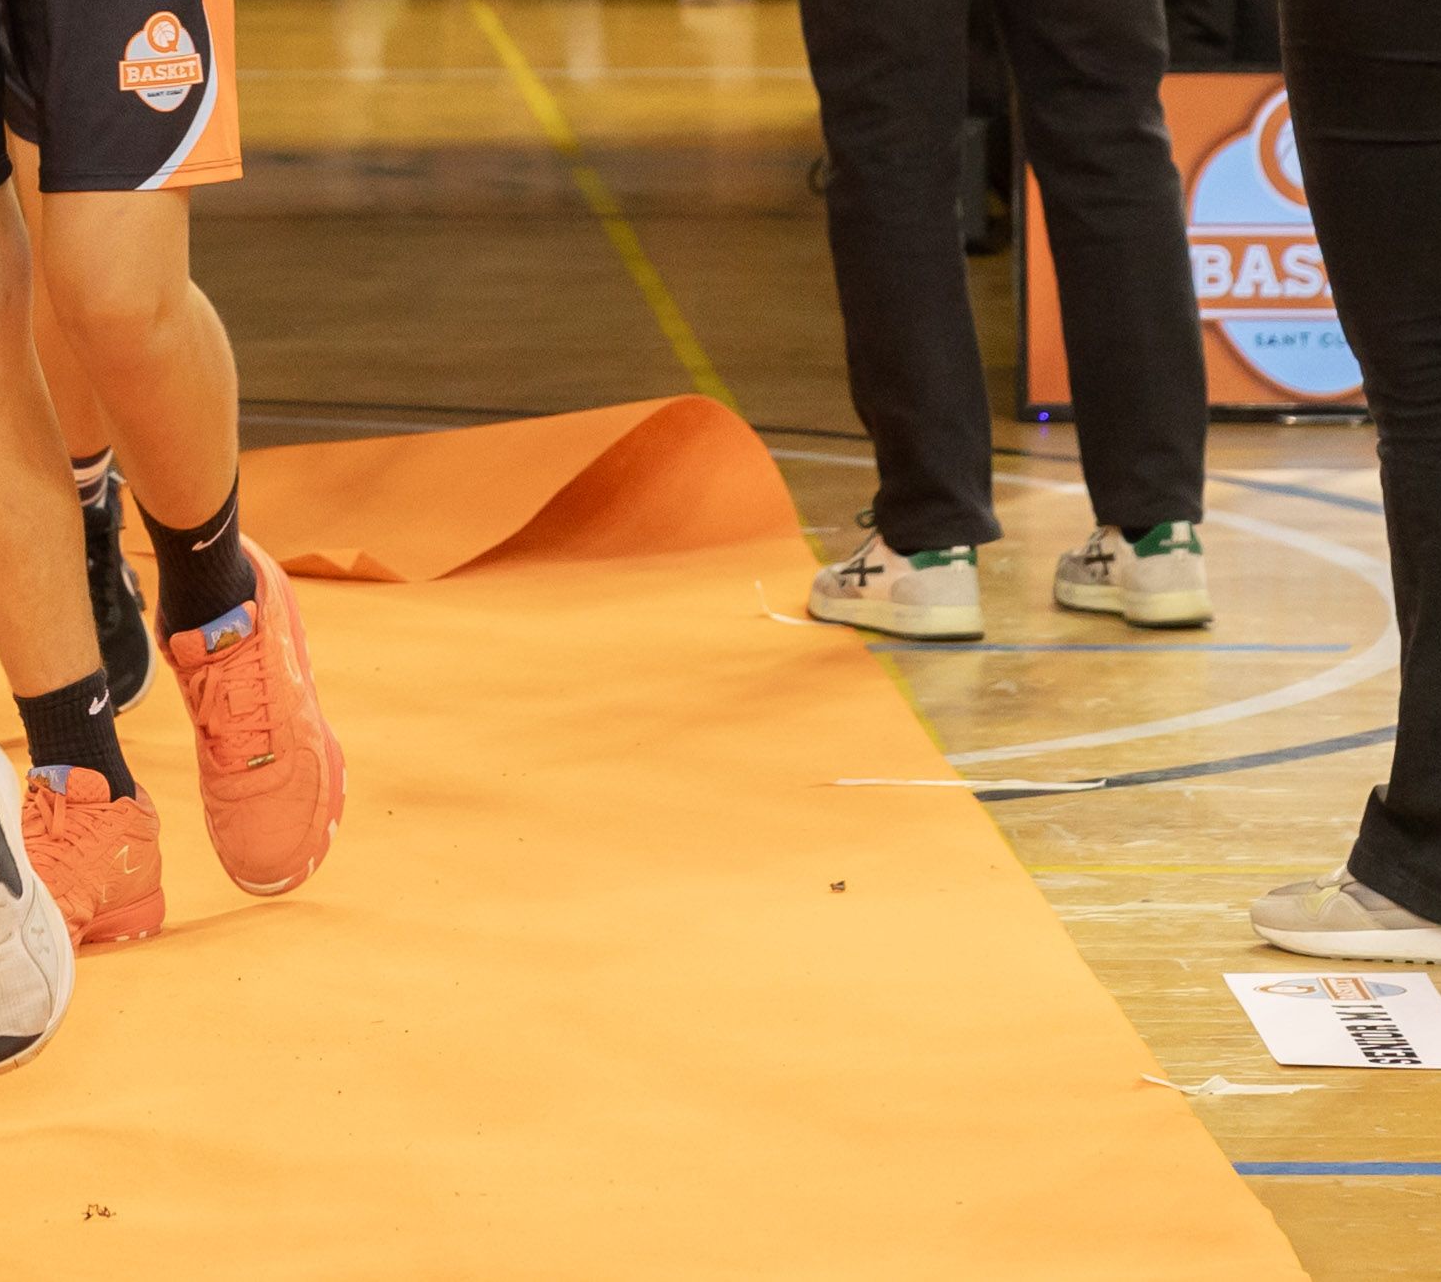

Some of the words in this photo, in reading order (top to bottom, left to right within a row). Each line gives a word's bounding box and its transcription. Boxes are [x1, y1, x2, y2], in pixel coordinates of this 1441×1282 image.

[125, 60, 197, 84] BASKET
[1189, 243, 1333, 299] BAS
[1345, 1023, 1423, 1066] SENIOR
